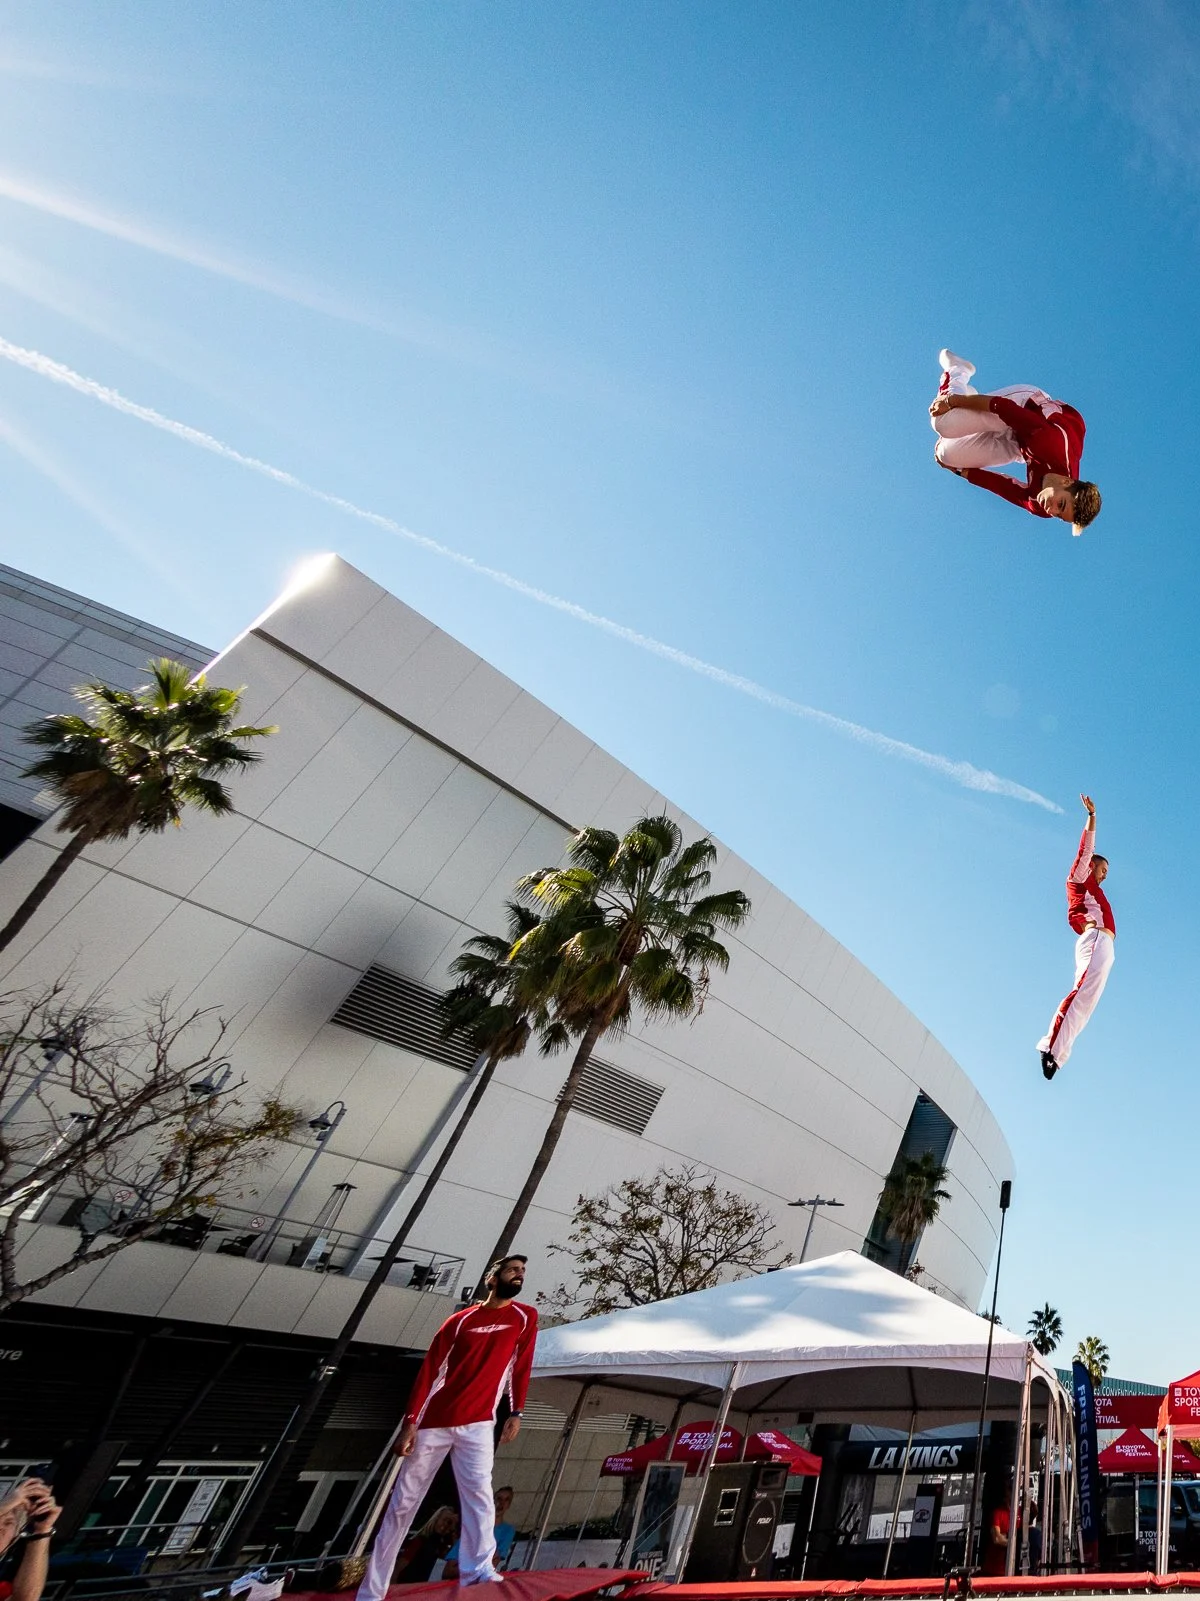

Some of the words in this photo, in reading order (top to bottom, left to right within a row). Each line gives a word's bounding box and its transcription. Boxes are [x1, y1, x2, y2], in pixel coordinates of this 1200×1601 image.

[1077, 1383, 1088, 1435] FREE
[1094, 1398, 1112, 1407] OTA
[693, 1431, 732, 1439] TOYTA
[689, 1442, 733, 1451] FESTAL
[868, 1447, 898, 1469] LA
[897, 1444, 963, 1470] KINGS
[1079, 1437, 1092, 1530] CLINICS
